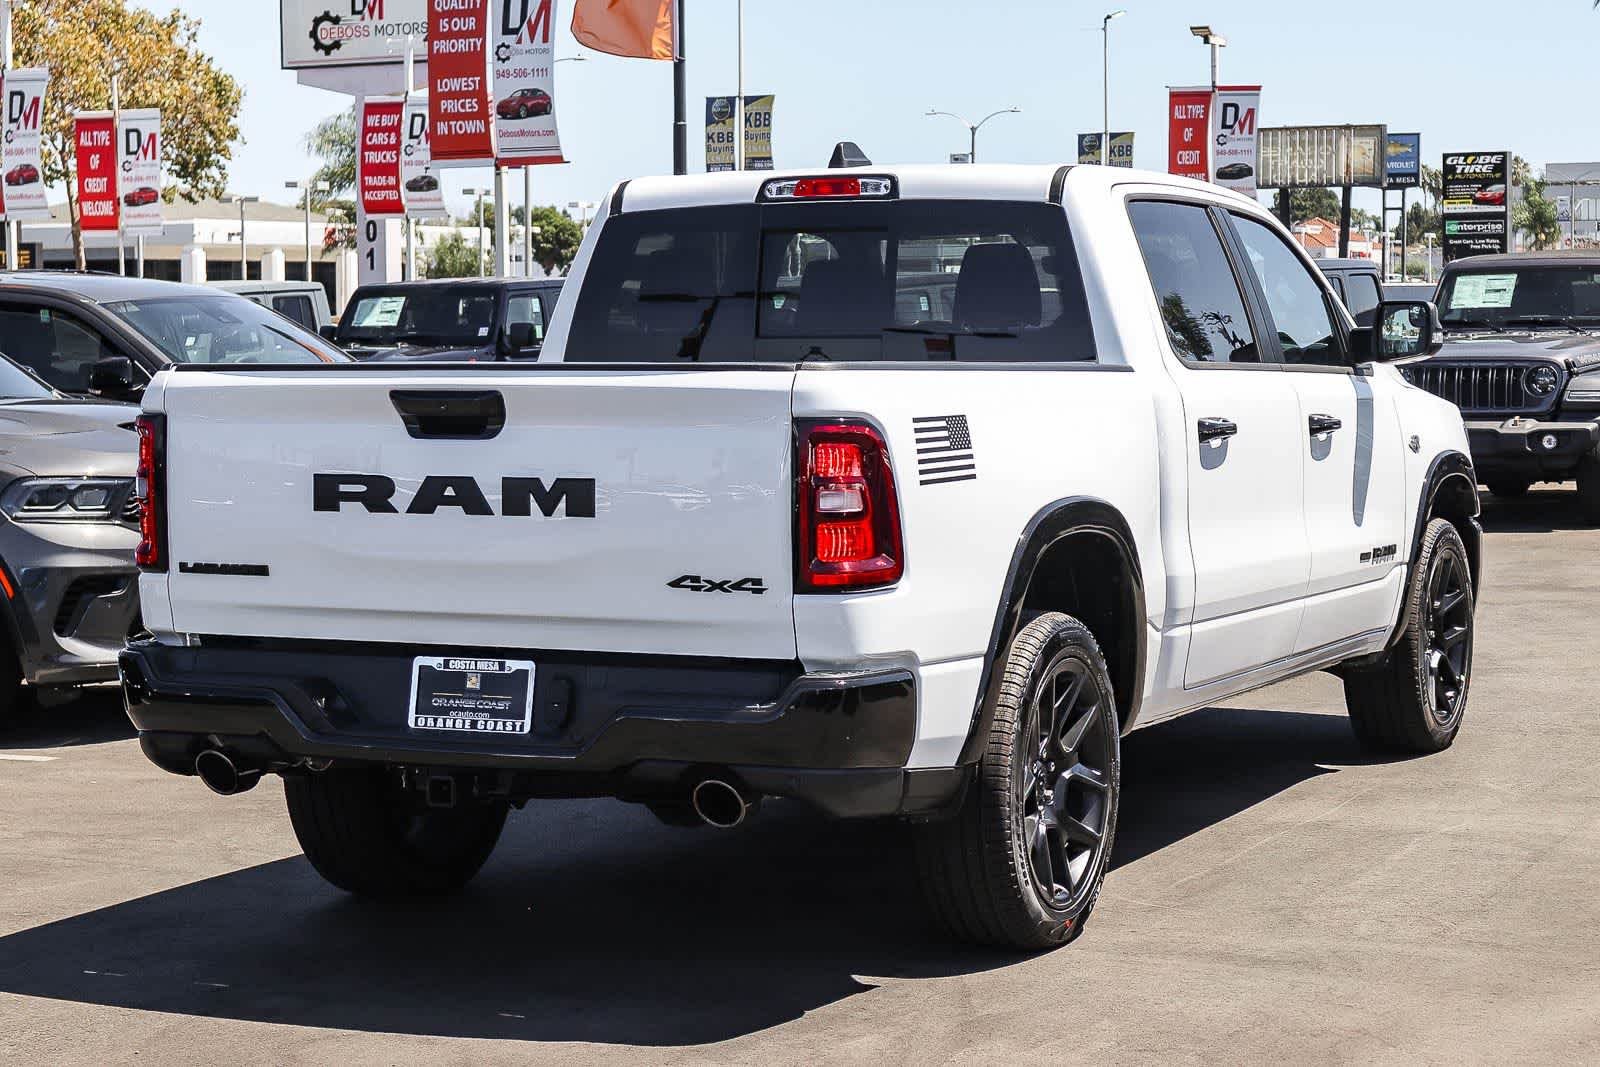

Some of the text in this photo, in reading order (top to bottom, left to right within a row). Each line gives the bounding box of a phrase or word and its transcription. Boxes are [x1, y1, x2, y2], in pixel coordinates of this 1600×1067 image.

[320, 21, 429, 40] DEBOSS MOTORS
[439, 17, 476, 32] IS OUR
[433, 38, 482, 53] PRIORITY
[496, 67, 548, 79] 949-506-1111
[437, 77, 480, 92] LOWEST
[9, 91, 41, 130] DM
[441, 99, 478, 113] PRICES
[1175, 105, 1204, 119] ALL TYPE
[367, 114, 400, 127] WE BUY
[745, 112, 771, 128] KBB
[1221, 102, 1255, 136] DM
[437, 120, 485, 135] IN TOWN
[499, 129, 555, 138] DebossMotors.com
[80, 130, 110, 146] ALL TYPE
[366, 132, 397, 145] CARS &
[707, 132, 734, 143] KBB
[745, 131, 771, 142] Buying
[1184, 128, 1193, 142] OF
[126, 128, 157, 160] DM
[707, 145, 735, 154] Buying
[1110, 144, 1132, 157] KBB
[90, 154, 100, 170] OF
[364, 151, 397, 163] TRUCKS
[1177, 150, 1200, 164] CREDIT
[1446, 155, 1504, 165] GLOBE
[1386, 161, 1415, 169] VROLET
[1455, 164, 1494, 173] TIRE
[84, 177, 108, 193] CREDIT
[364, 176, 396, 186] TRADE-IN
[365, 190, 398, 200] ACCEPTED
[82, 200, 114, 216] WELCOME
[1447, 222, 1503, 231] enterprise
[313, 473, 596, 518] RAM
[665, 574, 769, 594] 4x4
[449, 660, 499, 671] COSTA MESA
[432, 697, 512, 710] ORANGE COAST
[449, 710, 490, 719] ocauto.com
[417, 717, 522, 732] ORANGE COAST
